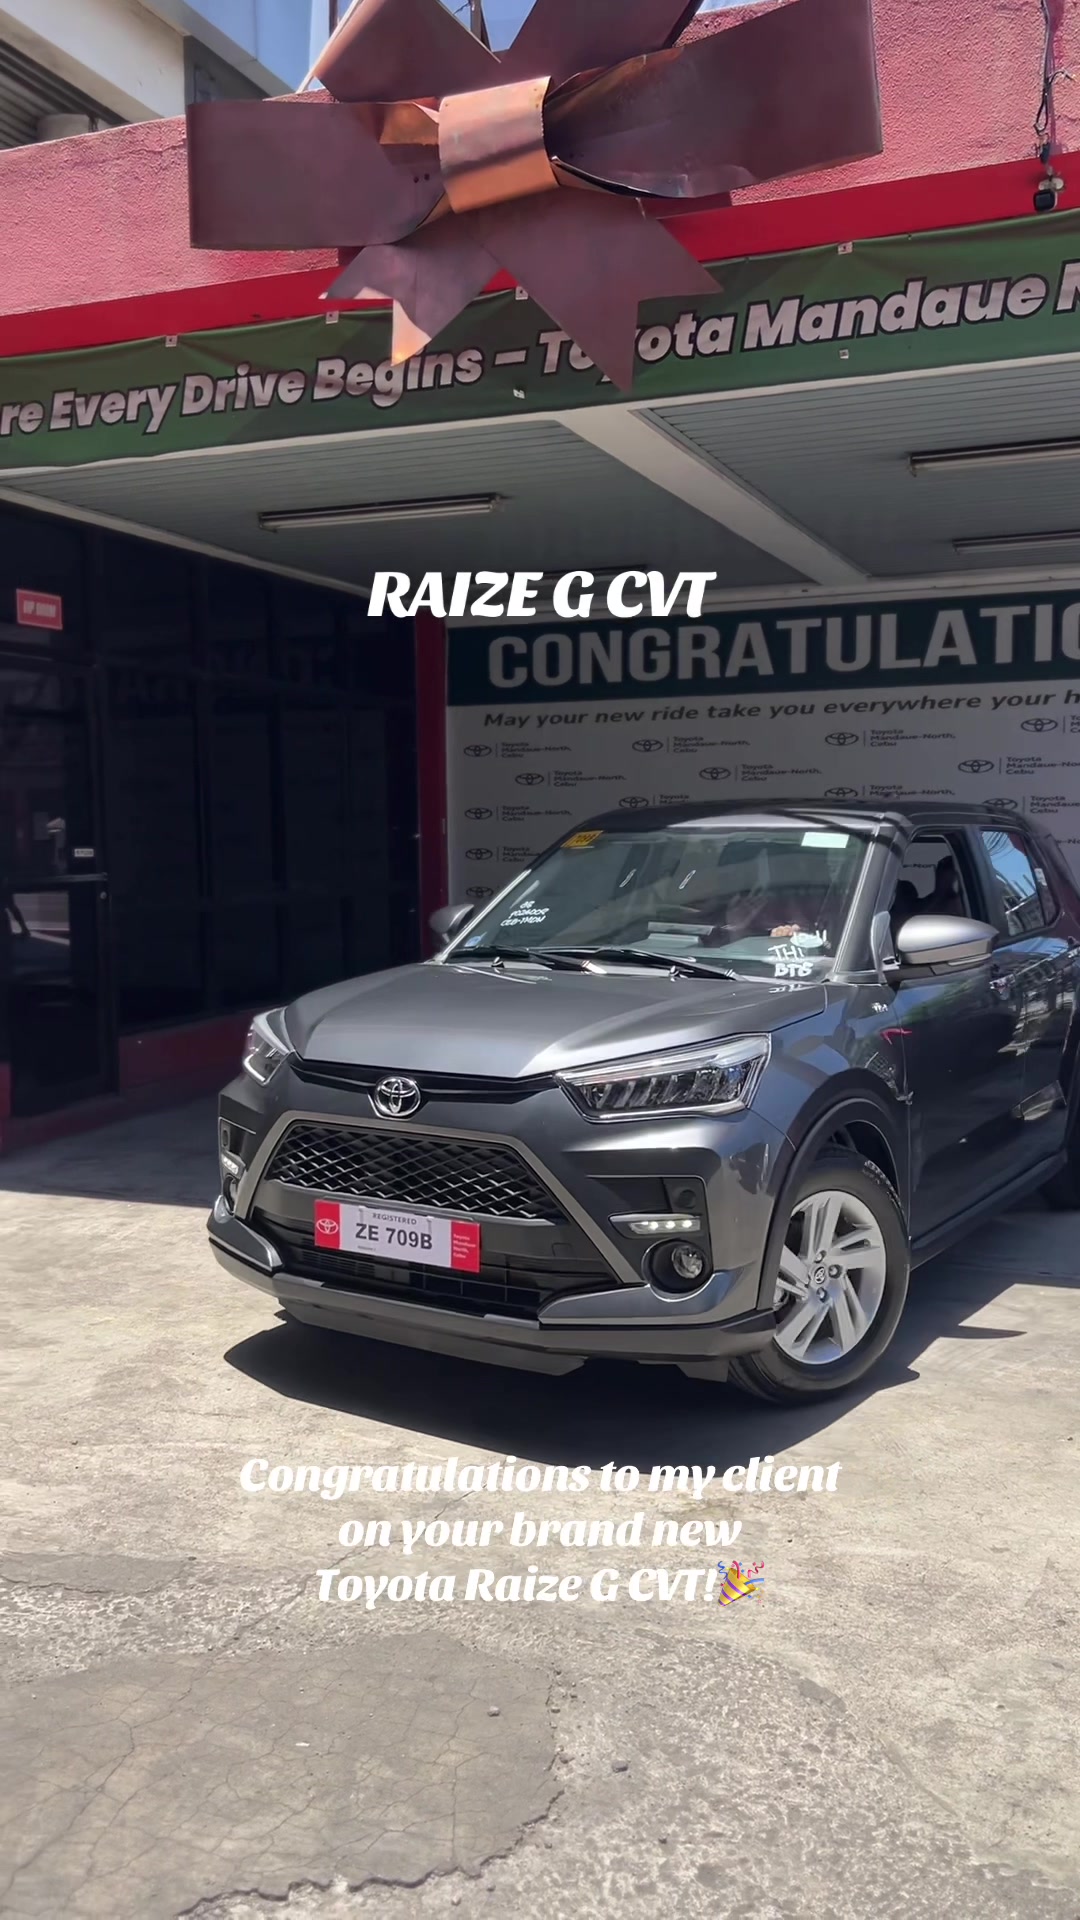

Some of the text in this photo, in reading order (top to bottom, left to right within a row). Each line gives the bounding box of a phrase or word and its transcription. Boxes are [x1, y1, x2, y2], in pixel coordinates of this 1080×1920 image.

[48, 383, 179, 435] Every
[180, 362, 305, 417] Drive
[312, 347, 484, 408] Begins
[537, 311, 737, 384] Toota
[741, 274, 1048, 351] Mandaue
[483, 713, 531, 728] May
[536, 712, 589, 728] your
[594, 709, 645, 724] new
[651, 706, 699, 722] ride
[707, 704, 761, 720] take
[769, 703, 815, 719] you
[823, 695, 982, 714] everywhere
[991, 692, 1056, 710] your
[372, 1212, 417, 1225] REGISTERED
[355, 1223, 433, 1250] ZE 709B
